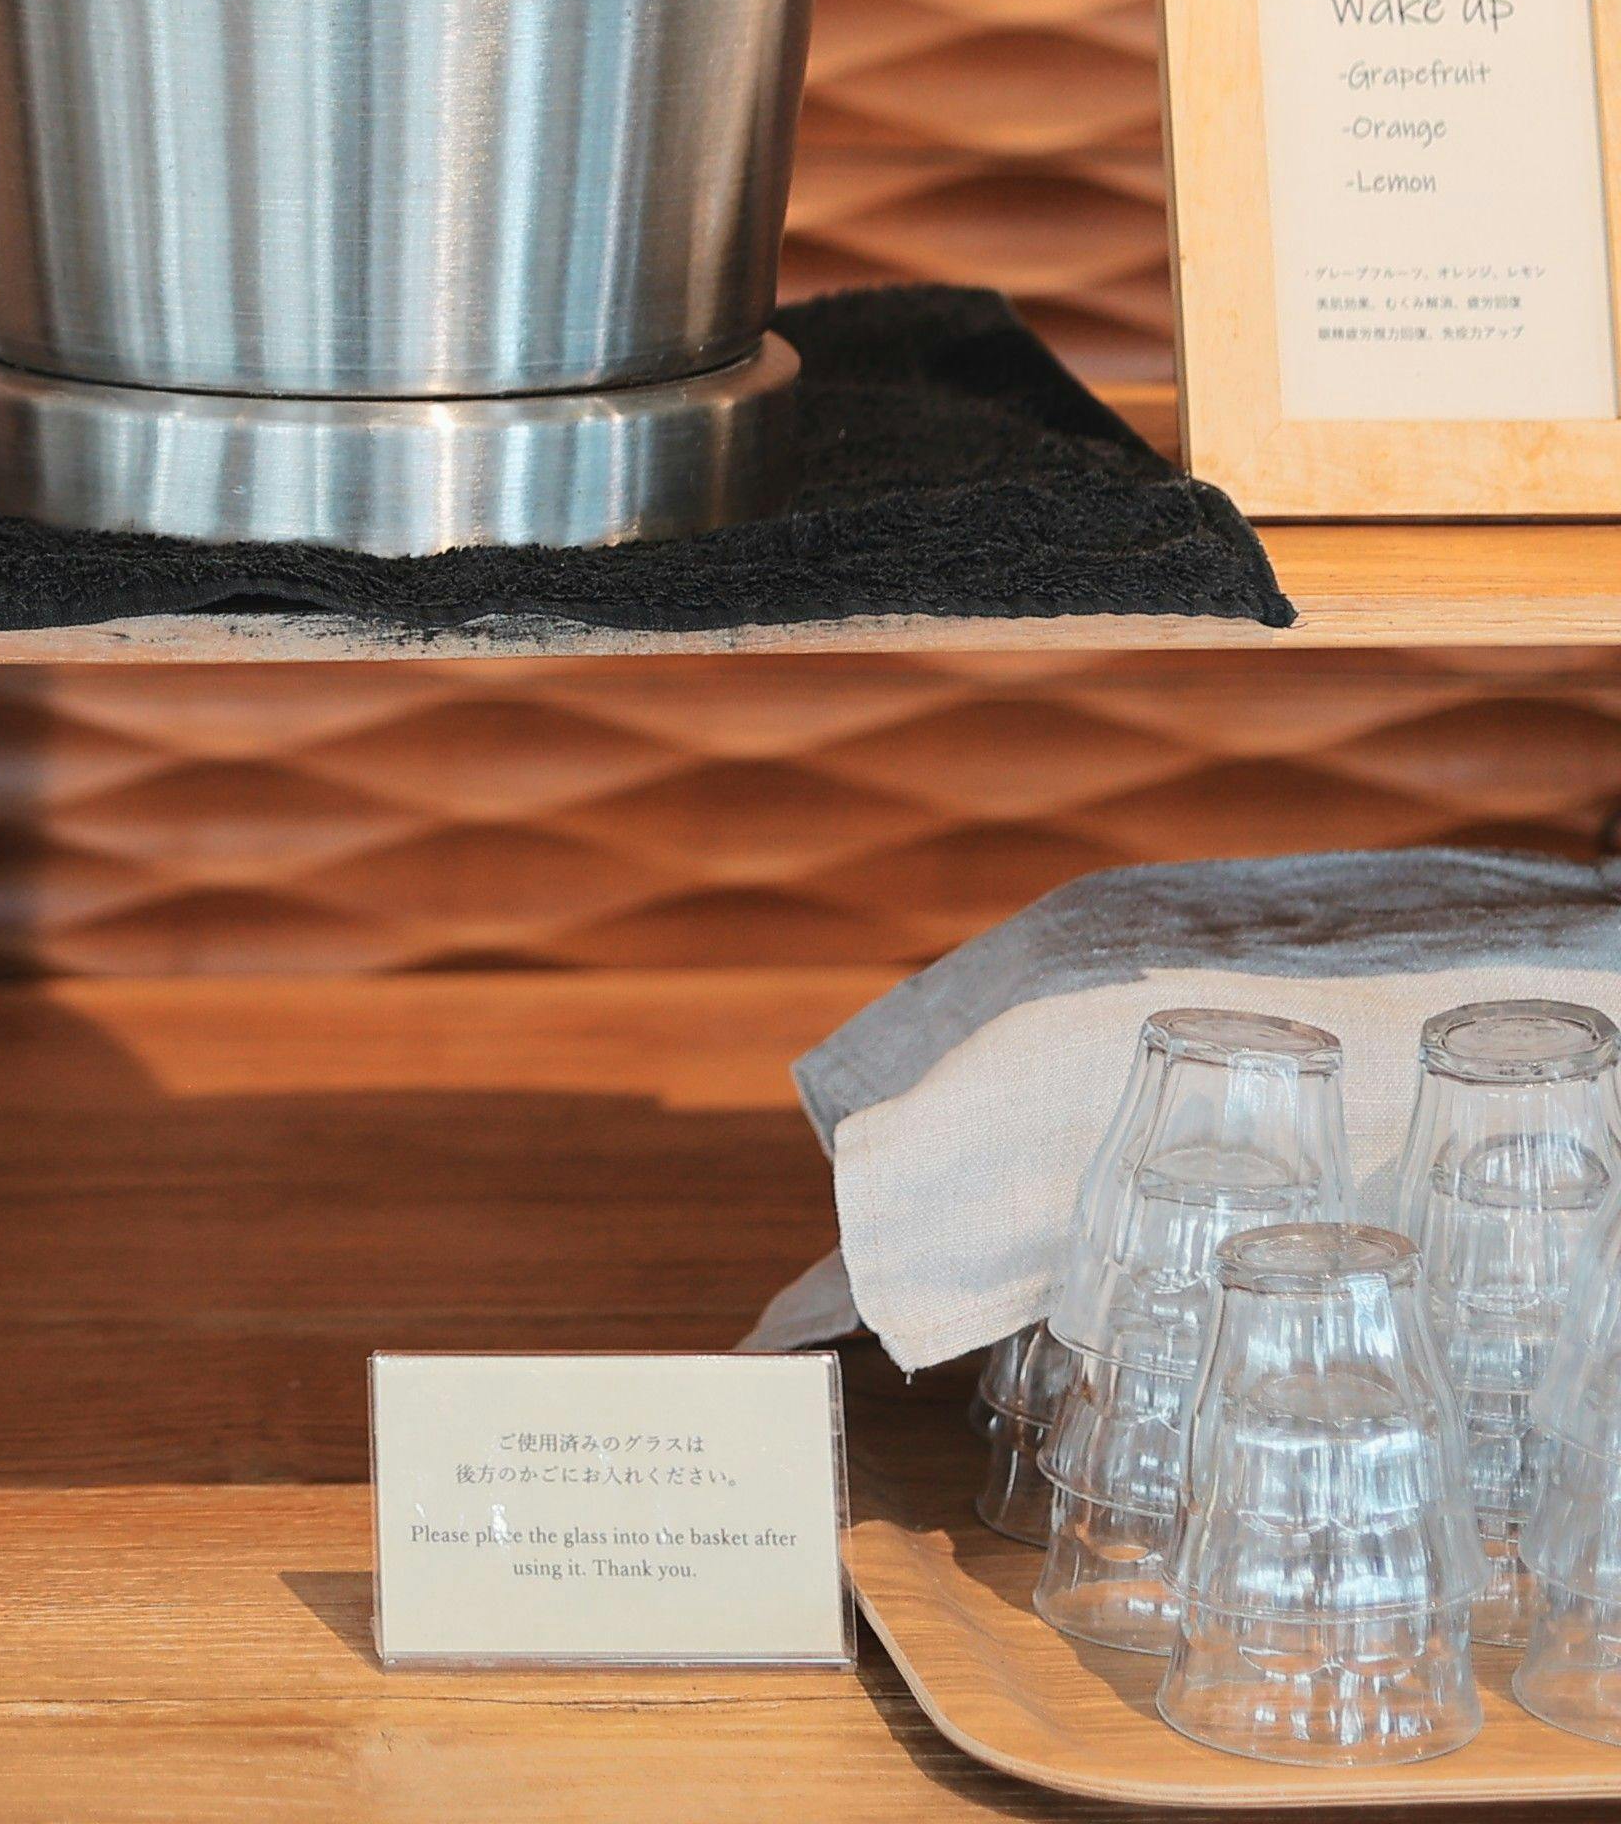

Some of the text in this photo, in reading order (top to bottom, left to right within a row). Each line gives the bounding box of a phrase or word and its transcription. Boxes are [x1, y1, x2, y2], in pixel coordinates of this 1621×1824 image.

[498, 1432, 706, 1454] ご使用済みのグラスは
[456, 1462, 738, 1488] 後方のかごにお入れください。
[410, 1524, 470, 1543] Please
[528, 1526, 558, 1544] the
[563, 1526, 607, 1548] glass
[613, 1527, 650, 1545] into
[656, 1526, 685, 1546] the
[690, 1527, 749, 1547] basket
[754, 1528, 797, 1547] after
[513, 1558, 697, 1582] using it. Thank you.
